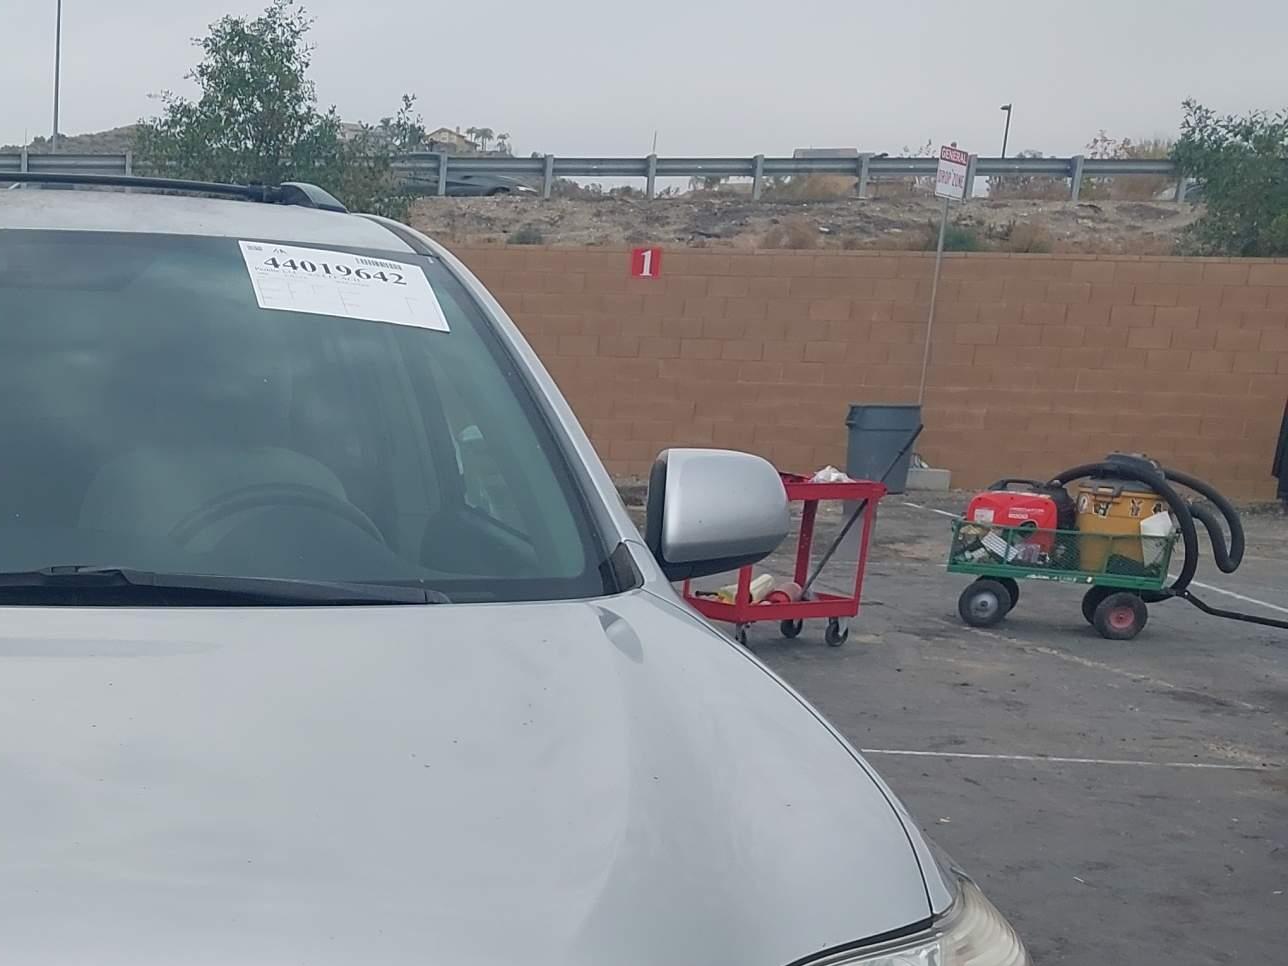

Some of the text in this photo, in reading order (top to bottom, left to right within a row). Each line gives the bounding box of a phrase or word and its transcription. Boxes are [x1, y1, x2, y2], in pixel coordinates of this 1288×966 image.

[941, 148, 967, 164] GENERAL
[263, 256, 407, 286] 44019642
[640, 250, 652, 276] 1
